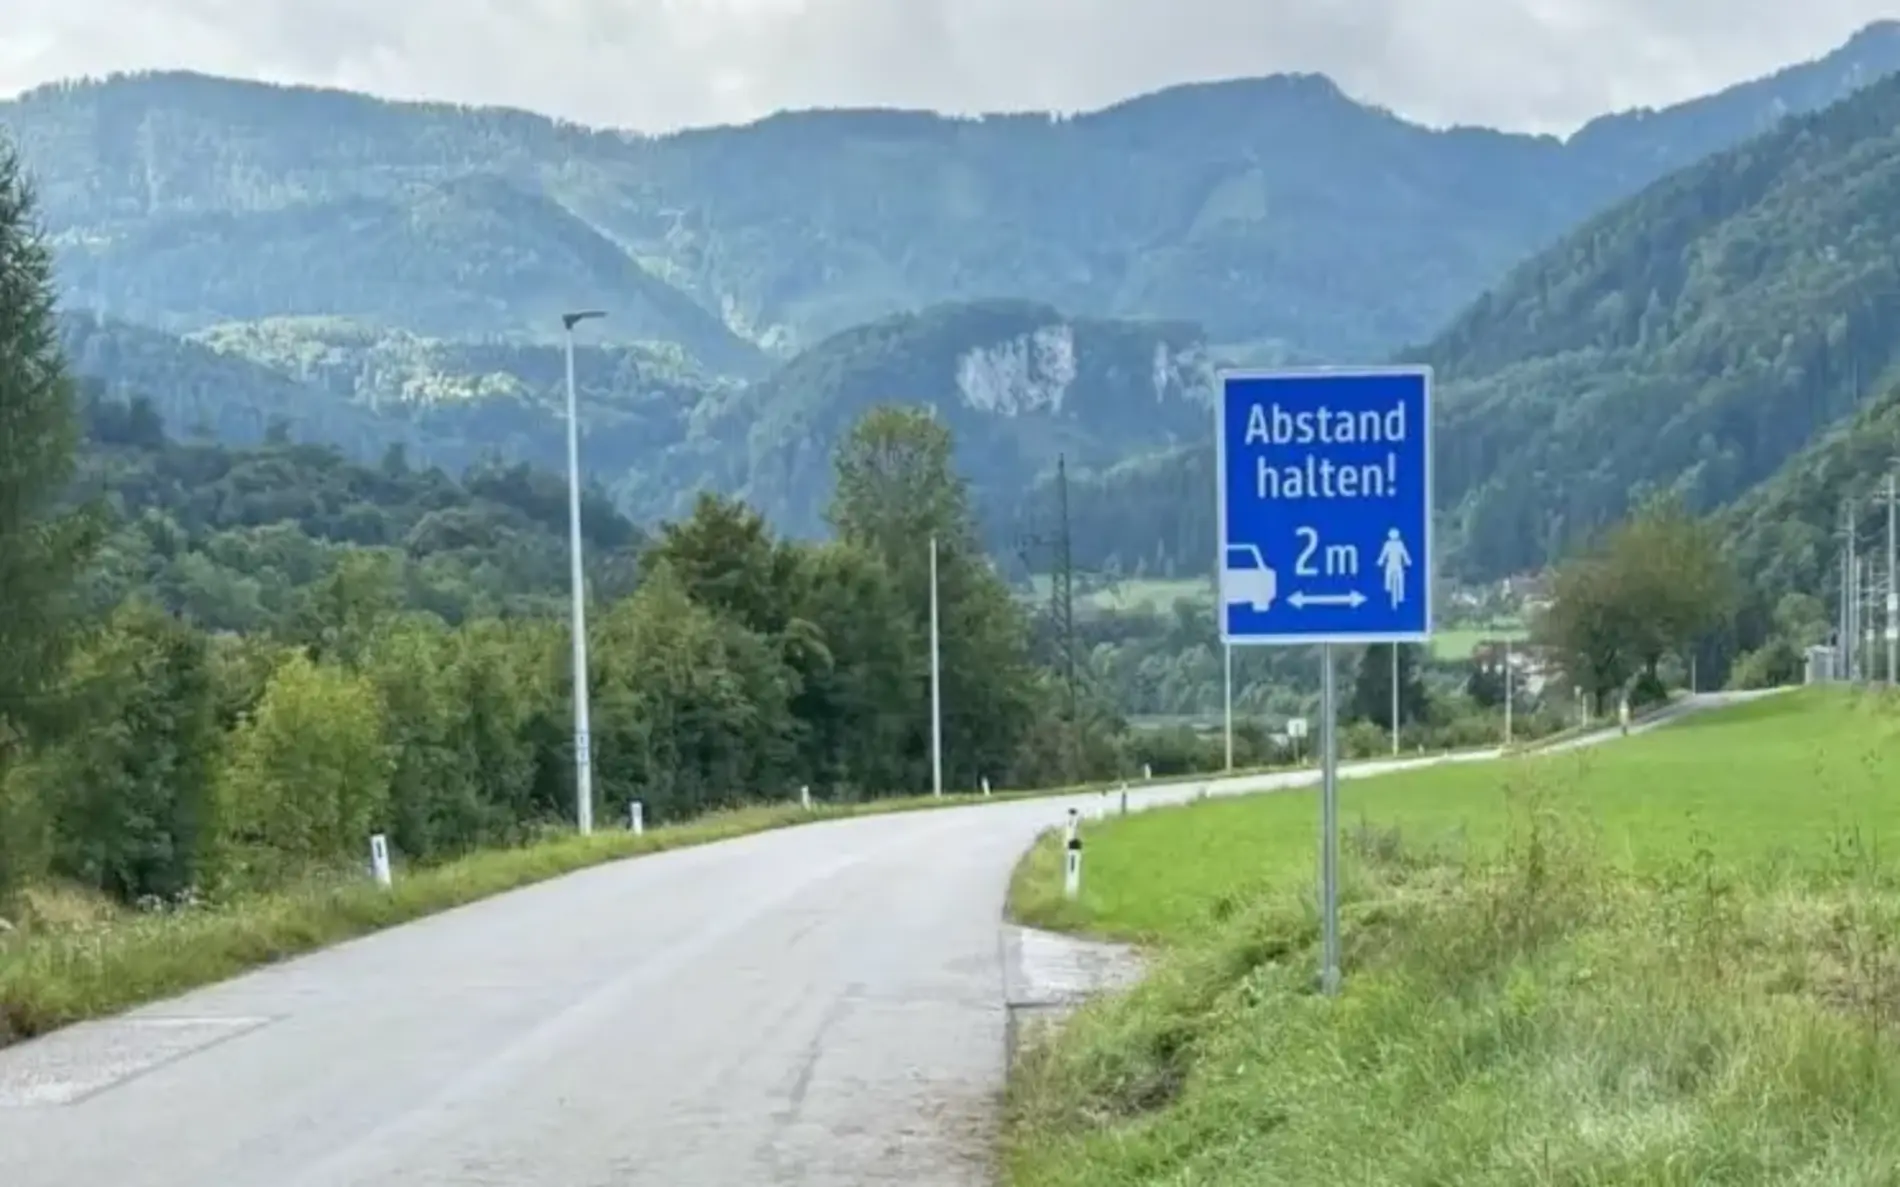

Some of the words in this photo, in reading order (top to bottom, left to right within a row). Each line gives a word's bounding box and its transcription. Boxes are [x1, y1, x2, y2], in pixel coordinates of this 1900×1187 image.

[1245, 400, 1406, 444] Abstand
[1257, 452, 1397, 498] halten!
[1295, 526, 1318, 576] 2
[1326, 543, 1358, 576] m
